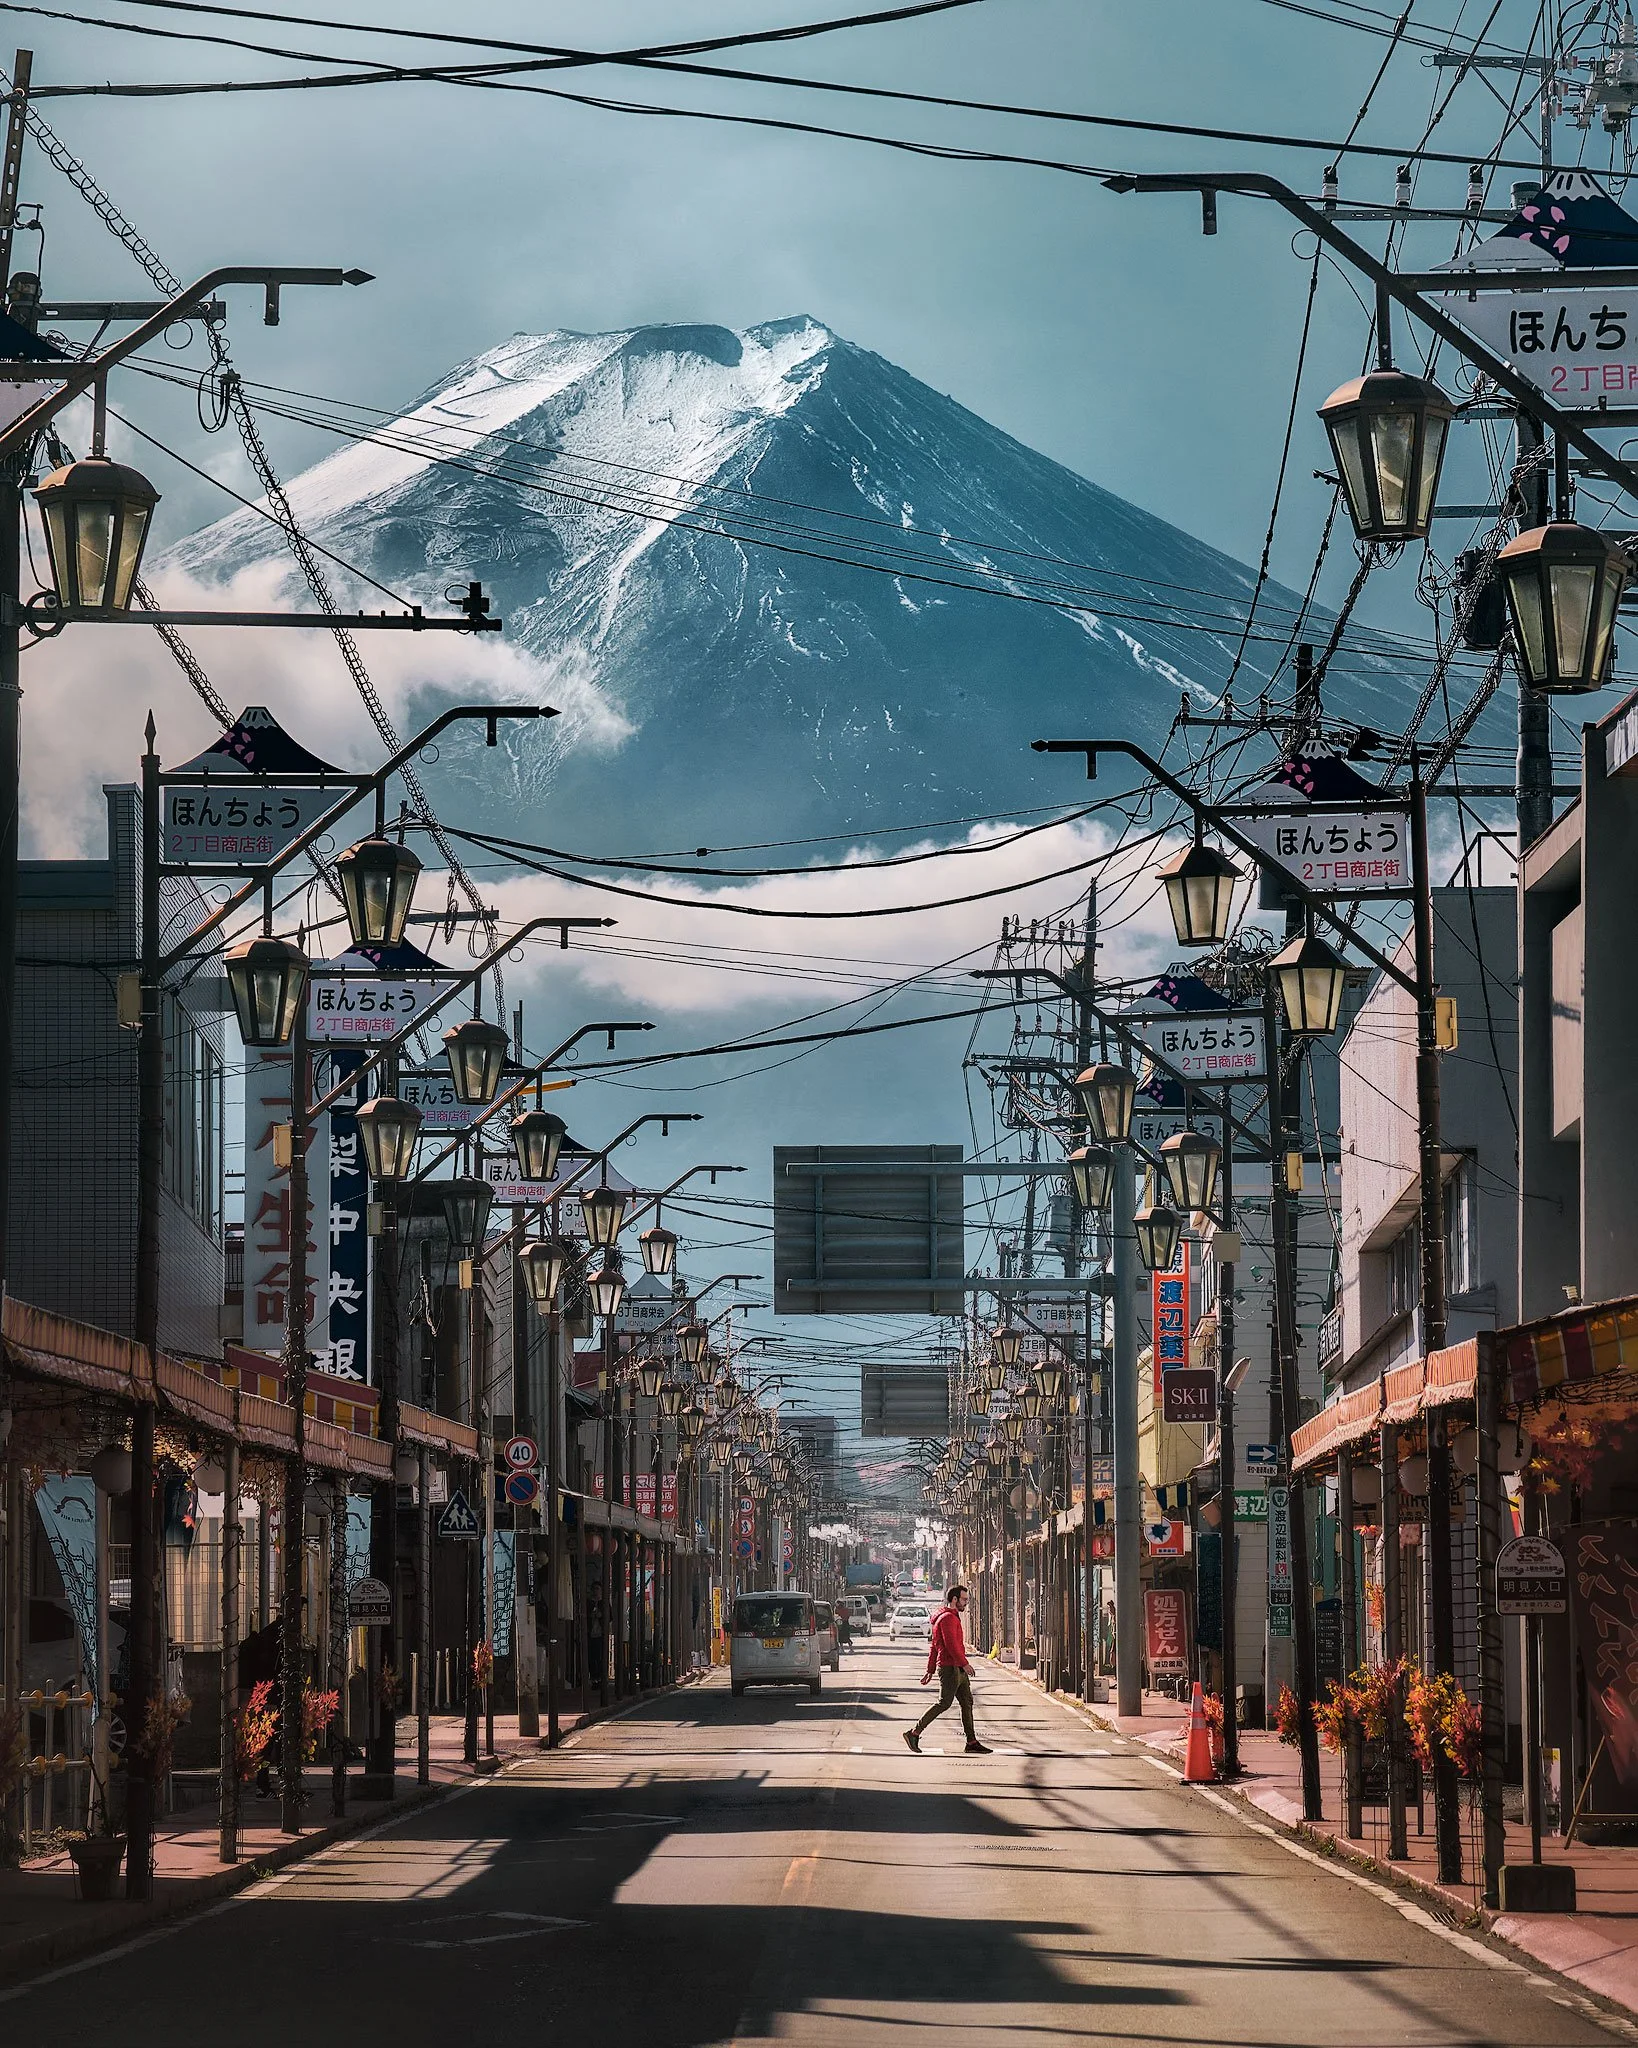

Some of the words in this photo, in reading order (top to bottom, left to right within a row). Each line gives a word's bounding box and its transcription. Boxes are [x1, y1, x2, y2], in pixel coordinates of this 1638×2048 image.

[1509, 304, 1638, 354] ほんち
[172, 796, 300, 829] ほんちょう
[171, 834, 274, 854] 2丁目商店街
[1276, 822, 1399, 856] ほんちょう
[1302, 858, 1400, 880] 2丁目商店街
[316, 987, 417, 1013] ほんちょう
[316, 1017, 396, 1033] 2丁目商店街
[1162, 1024, 1256, 1053] ほんちょう
[1182, 1053, 1257, 1071] 2丁目商店街
[425, 1110, 471, 1122] 目商店街
[1036, 1308, 1084, 1321] 3丁目商栄会
[1170, 1387, 1209, 1405] SK-II
[511, 1445, 531, 1461] 40
[741, 1501, 751, 1510] 40
[1503, 1581, 1561, 1593] 明見入口
[1153, 1595, 1179, 1655] 処方せん
